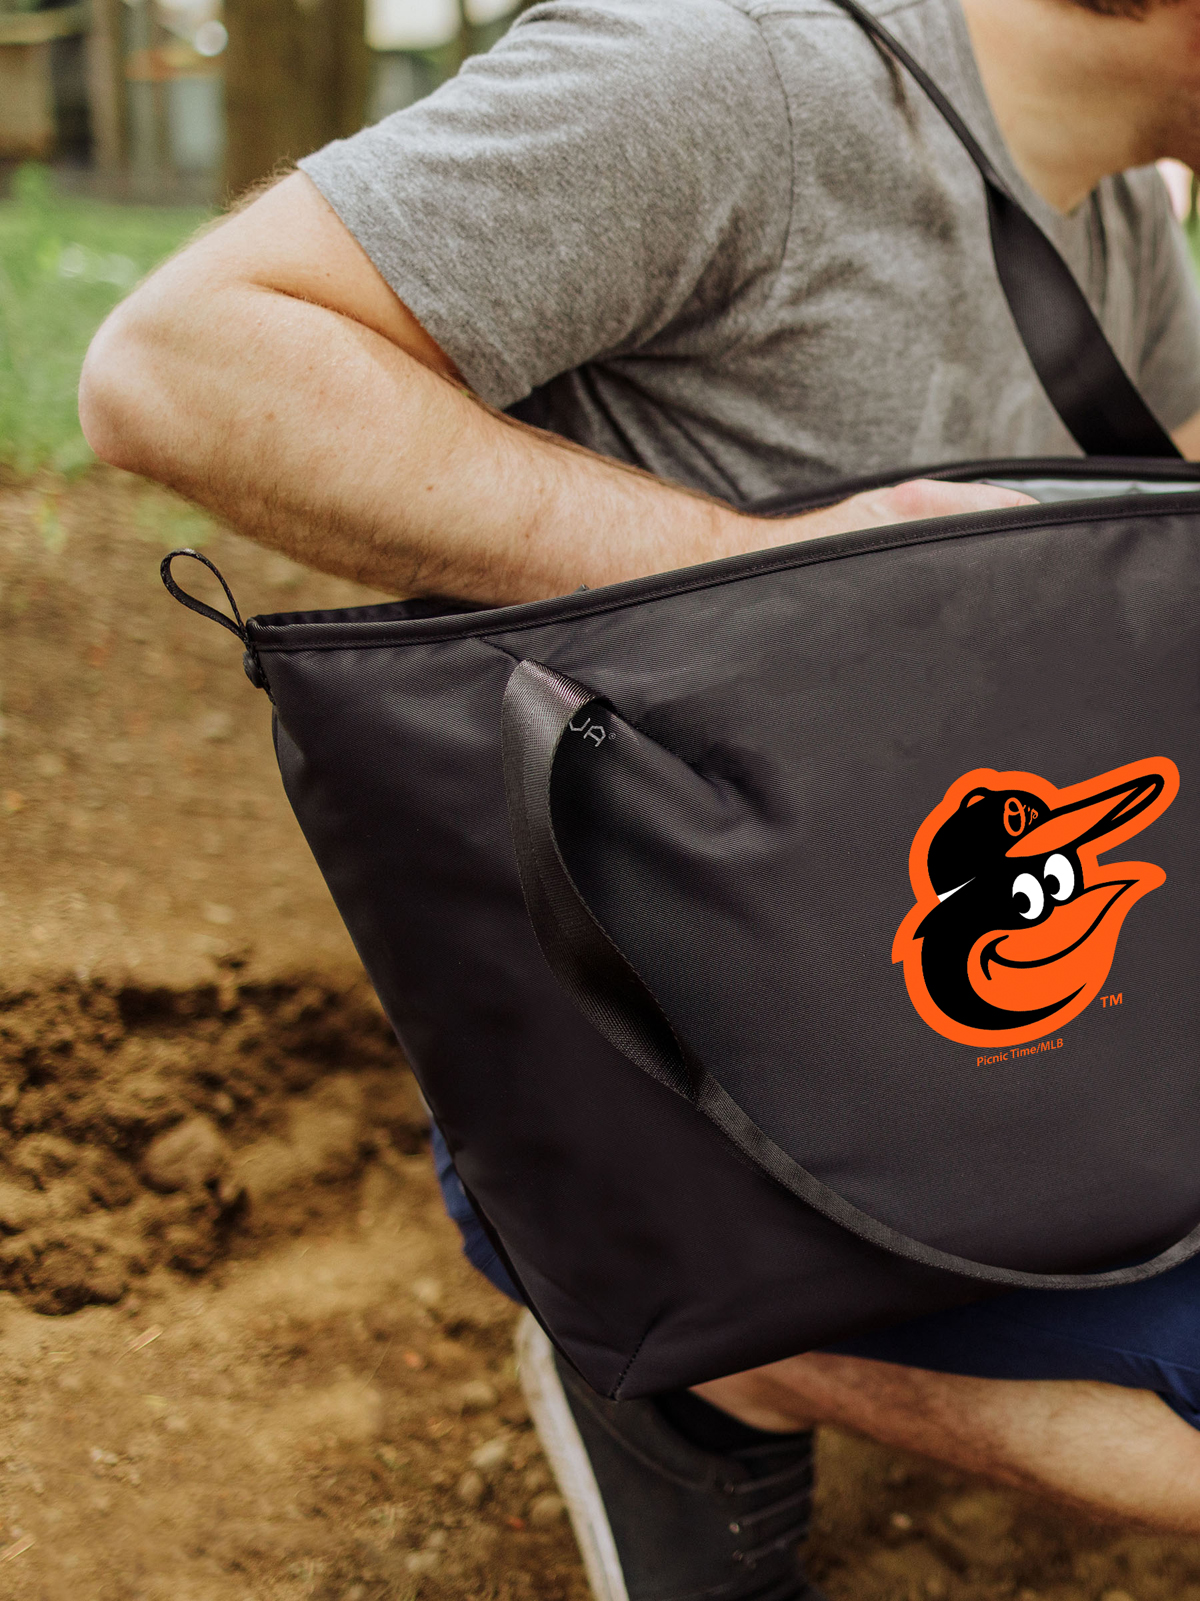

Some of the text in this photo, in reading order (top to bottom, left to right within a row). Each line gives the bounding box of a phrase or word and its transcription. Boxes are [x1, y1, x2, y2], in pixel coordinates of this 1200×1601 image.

[1100, 993, 1123, 1008] TM
[976, 1038, 1064, 1067] Picnic Time/MLB
